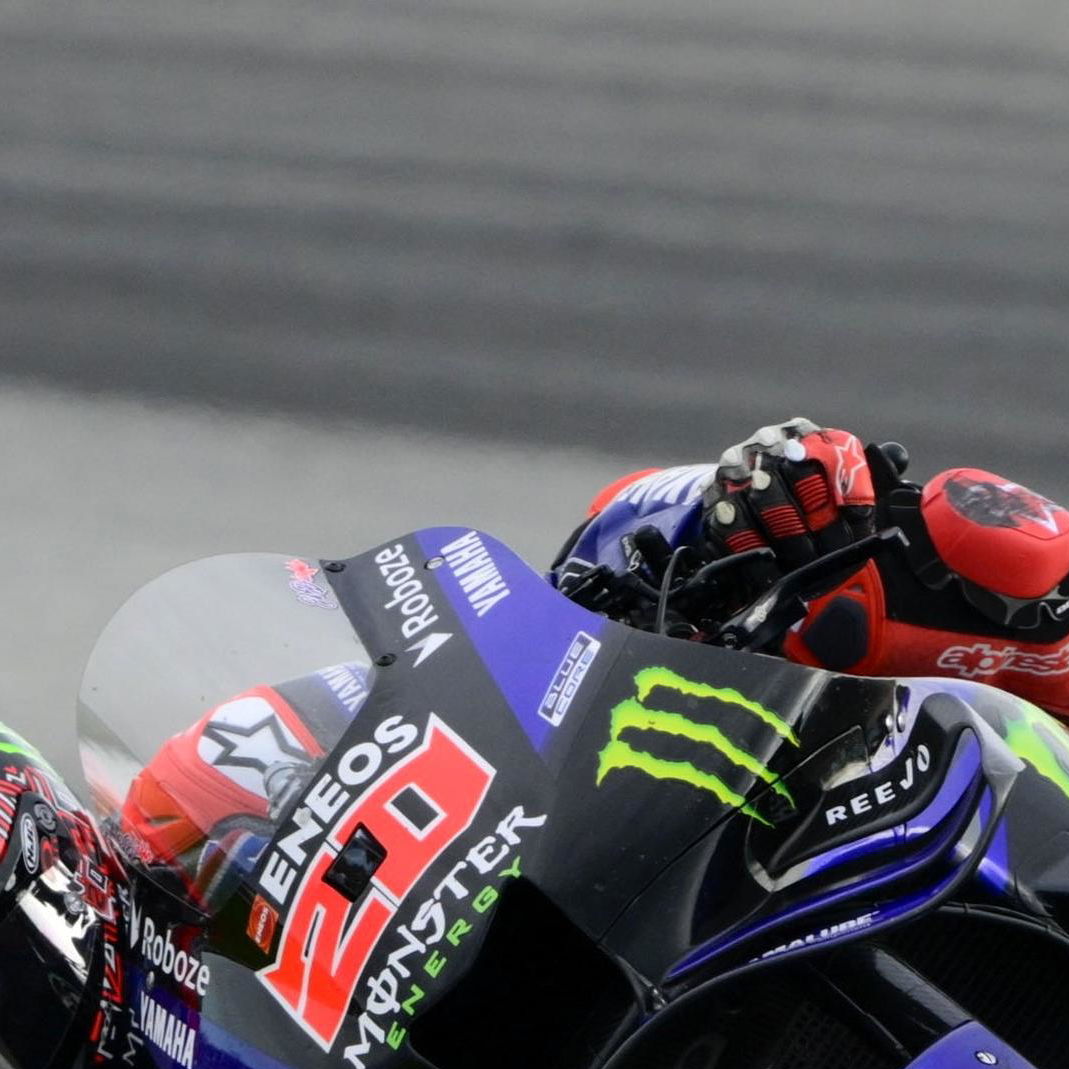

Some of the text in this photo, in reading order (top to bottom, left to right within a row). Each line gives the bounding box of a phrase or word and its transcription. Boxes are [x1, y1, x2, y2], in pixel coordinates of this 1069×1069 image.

[374, 543, 439, 639] Roboze
[440, 530, 511, 618] YAMAHA
[556, 650, 595, 716] CORE
[258, 715, 418, 905] ENEOS
[141, 916, 210, 997] Roboze
[386, 856, 522, 1050] ENERGY
